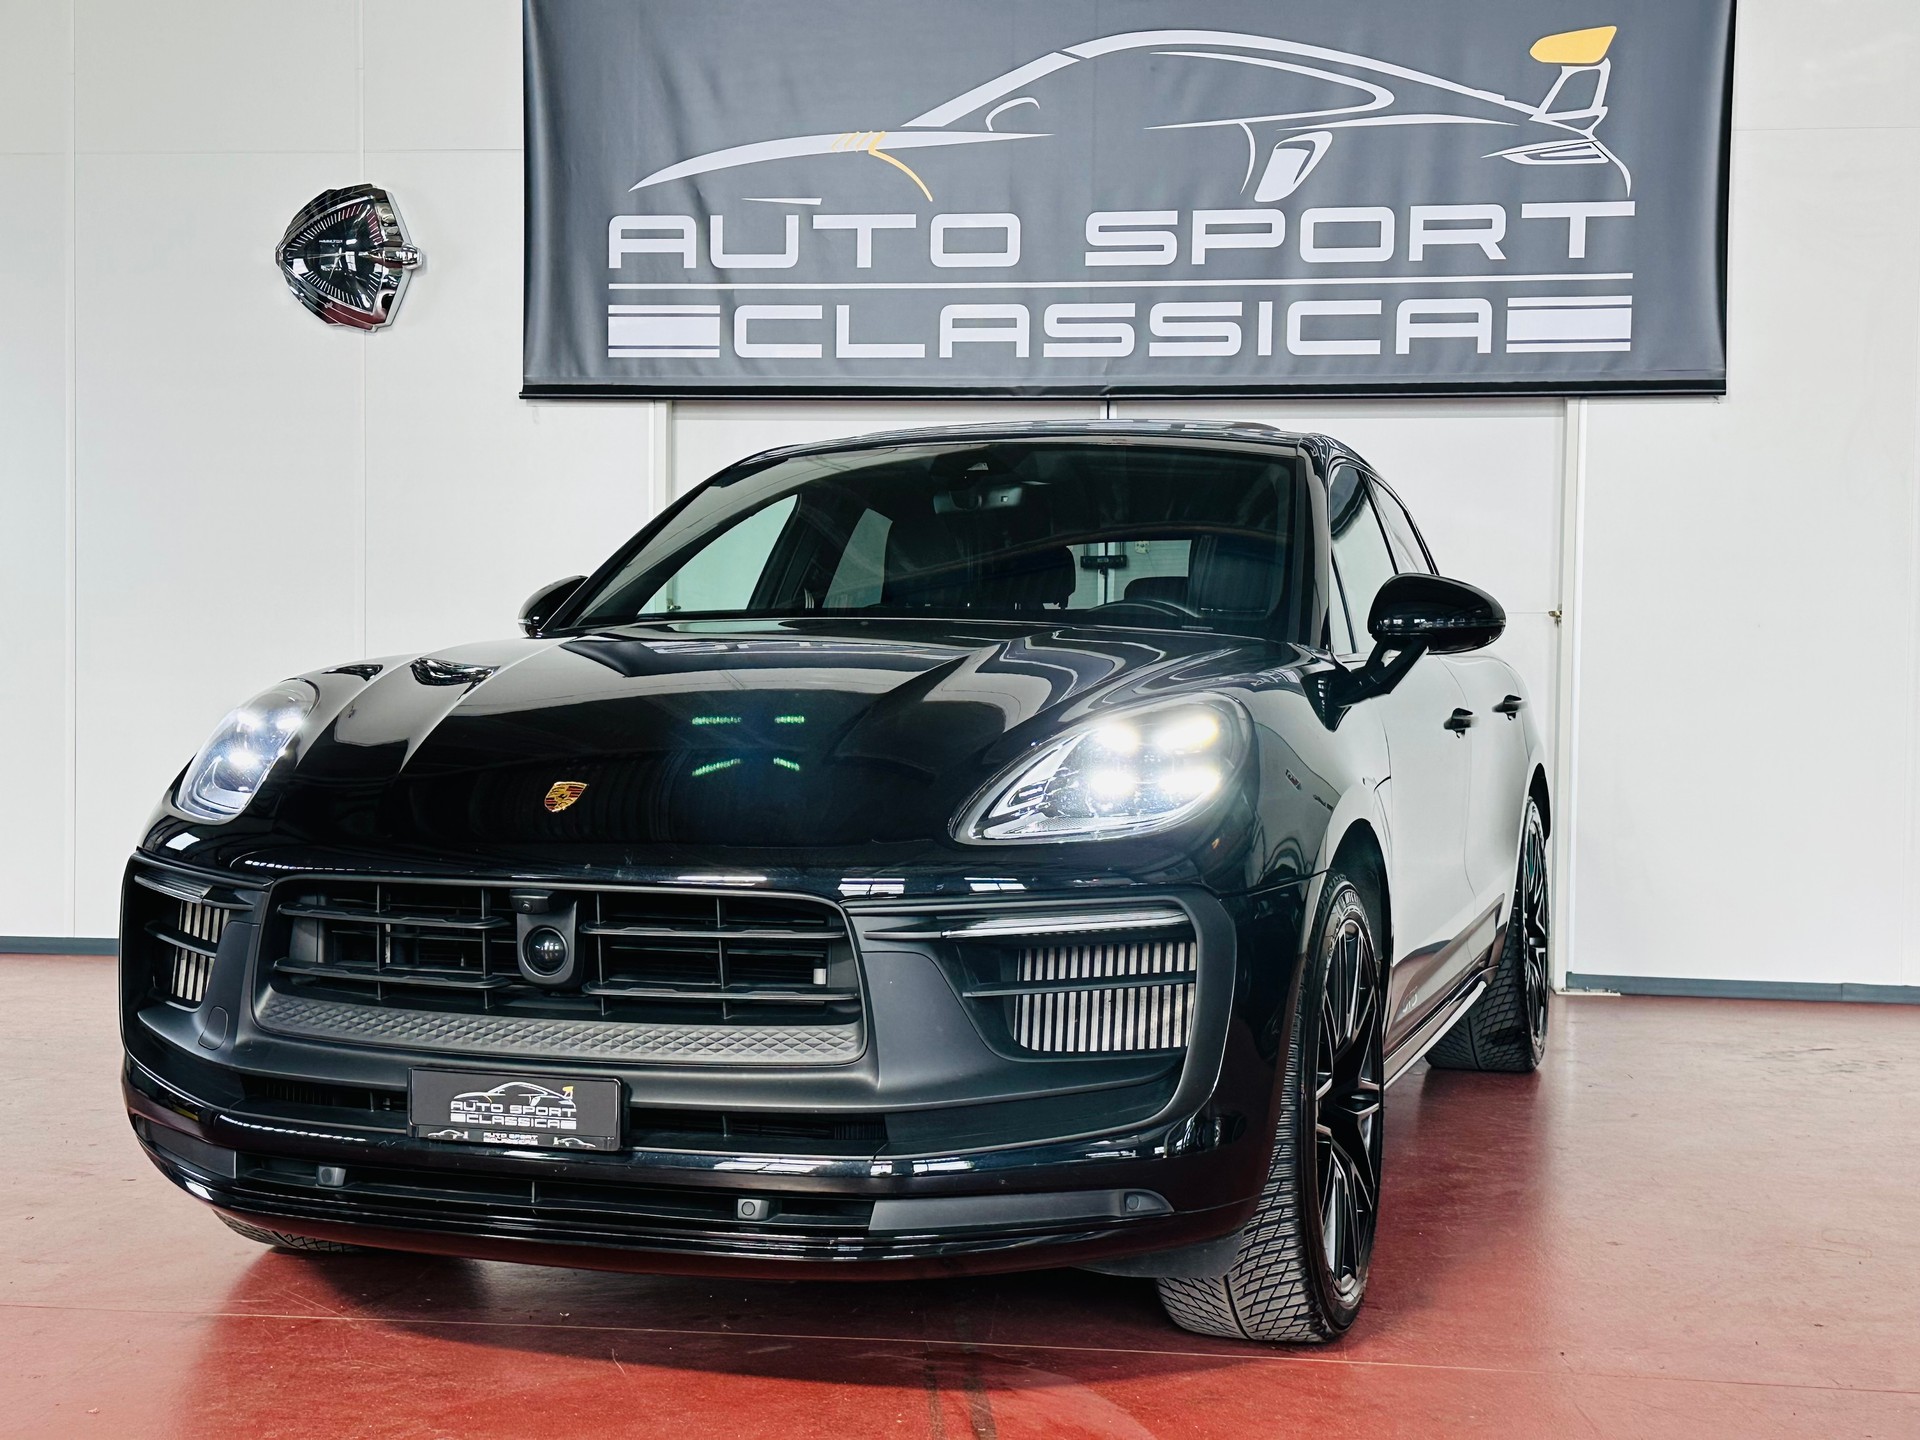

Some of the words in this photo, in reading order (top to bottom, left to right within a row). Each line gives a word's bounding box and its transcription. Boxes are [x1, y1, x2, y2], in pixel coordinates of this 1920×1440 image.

[609, 213, 1021, 269] AUTO
[1084, 201, 1636, 267] SPORT
[733, 299, 1493, 359] CLASSICA
[450, 1100, 504, 1113] AUTO
[509, 1104, 577, 1117] SPORT
[466, 1113, 560, 1129] CLASSICA
